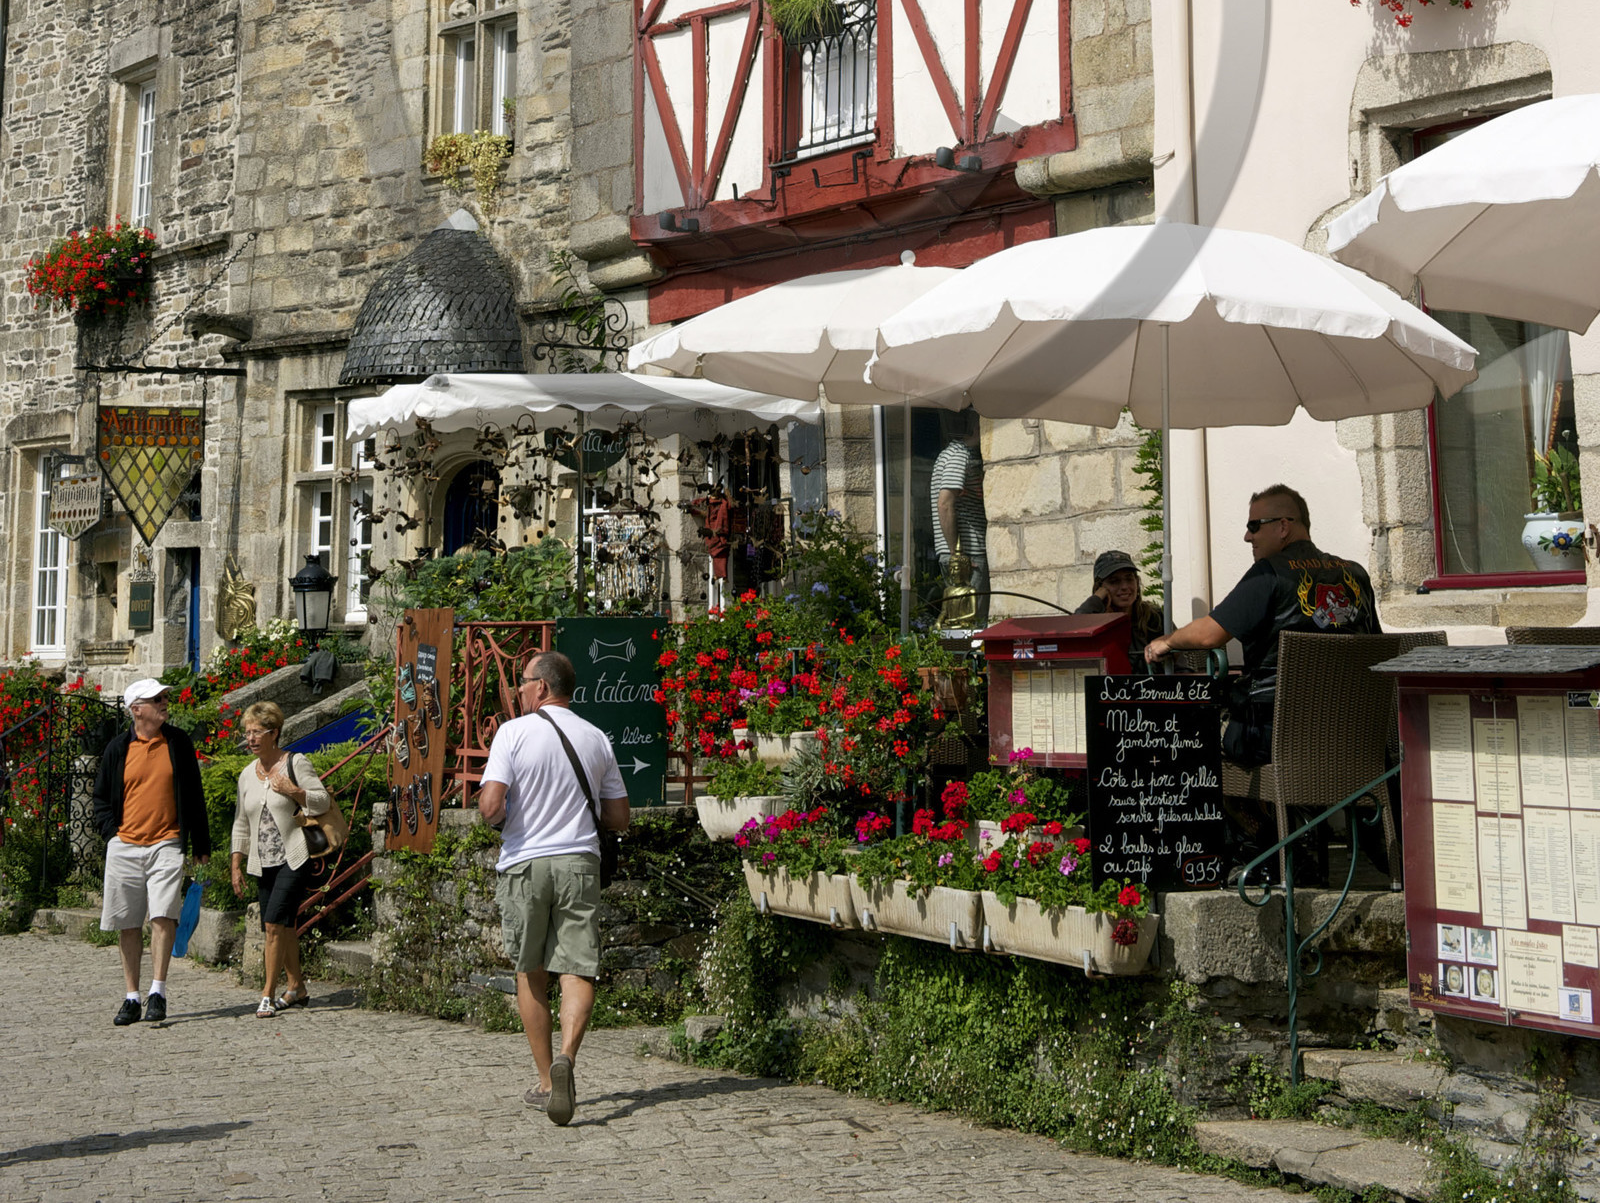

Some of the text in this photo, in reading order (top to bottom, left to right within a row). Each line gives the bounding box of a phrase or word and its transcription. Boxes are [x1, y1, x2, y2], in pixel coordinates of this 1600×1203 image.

[594, 671, 660, 703] tatane
[1100, 676, 1211, 701] La Formule été
[1106, 708, 1180, 732] Melon et
[620, 726, 653, 744] libre
[1116, 731, 1203, 763] jambon fumé
[1097, 767, 1128, 787] Côte
[1131, 768, 1144, 788] de
[1148, 772, 1175, 795] porc
[1108, 795, 1137, 807] sauce
[1157, 807, 1181, 833] frites
[1194, 802, 1223, 821] salade
[1099, 832, 1204, 868] 2 boules de glace
[1103, 862, 1124, 873] ou
